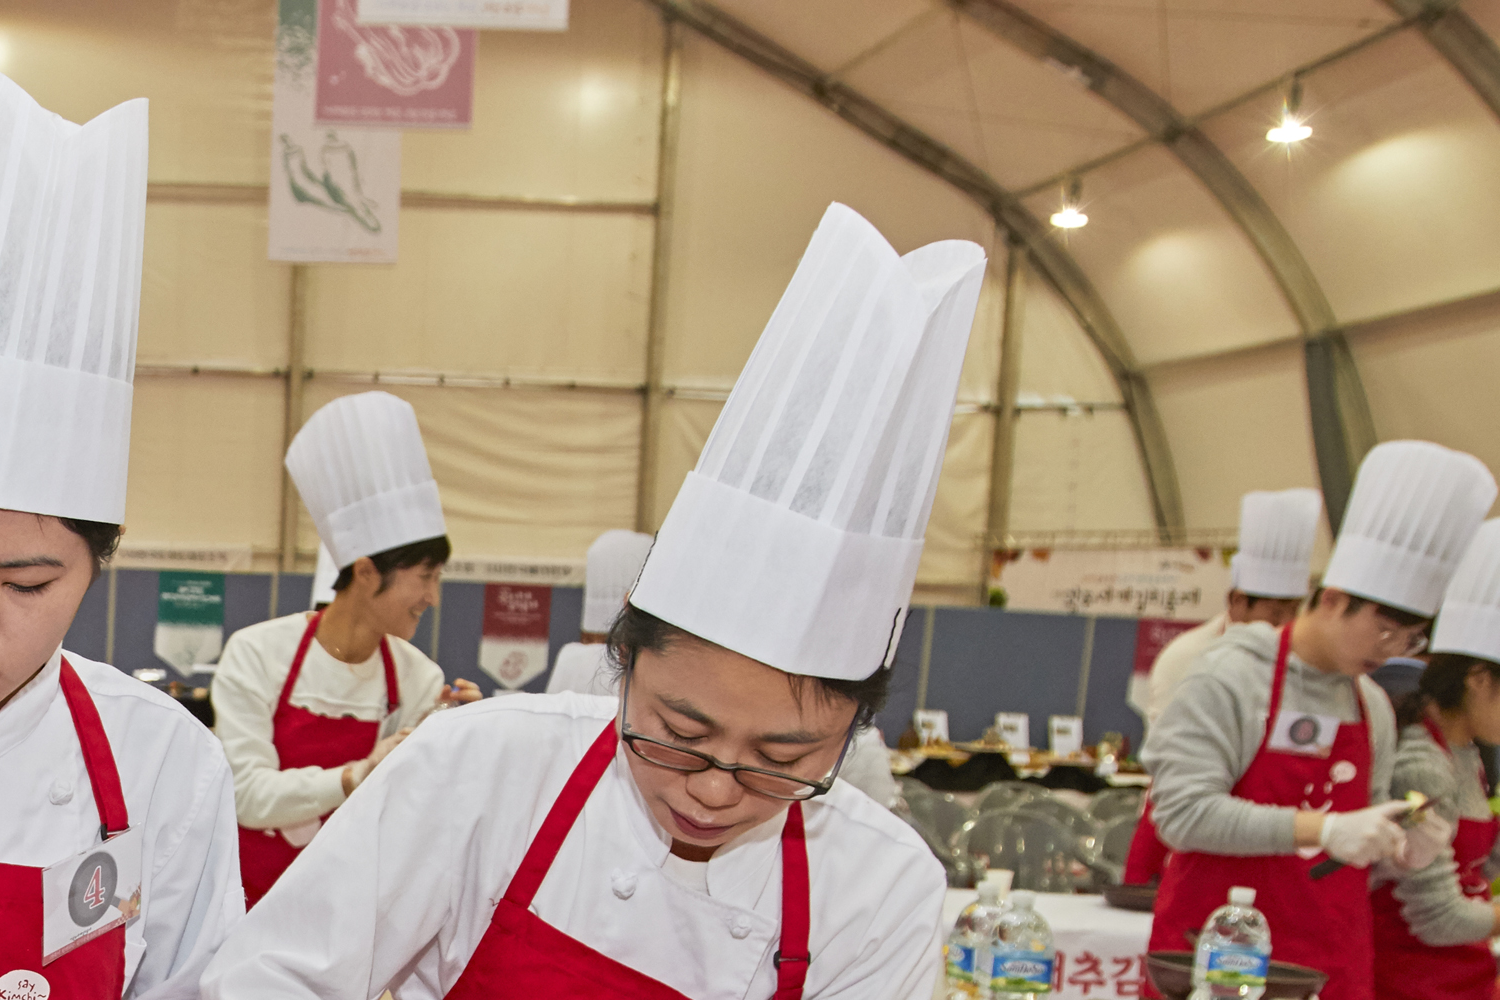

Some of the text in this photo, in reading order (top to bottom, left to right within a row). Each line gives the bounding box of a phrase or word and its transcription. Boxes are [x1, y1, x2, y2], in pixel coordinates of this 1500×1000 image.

[83, 865, 106, 910] 4
[17, 979, 36, 992] say
[1052, 951, 1145, 997] 추김
